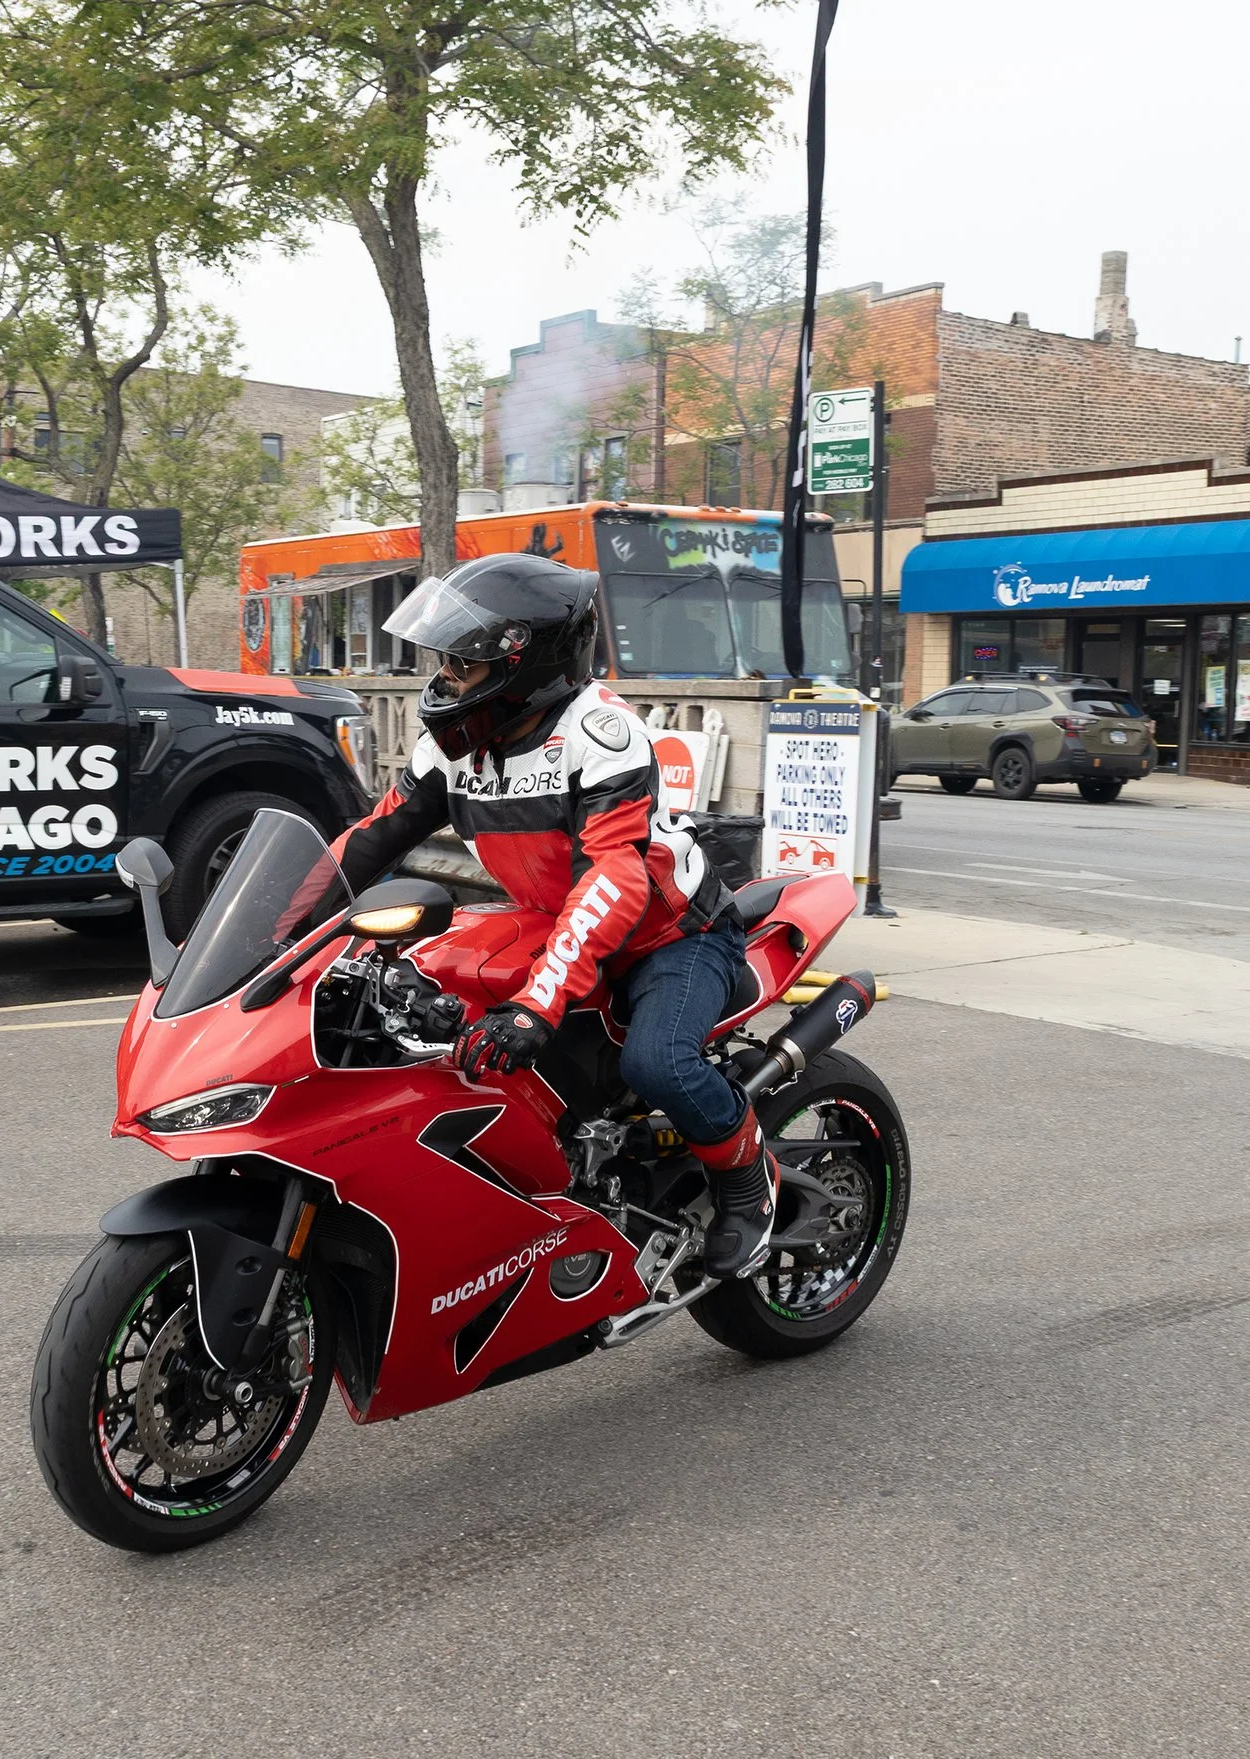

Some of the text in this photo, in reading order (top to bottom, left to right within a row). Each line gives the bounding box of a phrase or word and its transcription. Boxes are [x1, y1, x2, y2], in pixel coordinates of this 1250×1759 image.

[1016, 575, 1151, 602] Ramova Laundromat
[215, 706, 295, 726] Jay5k.com
[786, 741, 839, 760] SPOT HERO
[661, 765, 692, 784] NOT
[776, 764, 846, 786] PARKING ONLY
[780, 787, 842, 809] ALL OTHERS
[770, 810, 848, 835] WILL BE TOWED
[32, 853, 117, 876] 2004
[528, 874, 622, 1009] DUCATI
[529, 943, 548, 960] DUC
[206, 1074, 233, 1087] DUCATI
[290, 1384, 309, 1431] ANIGALE
